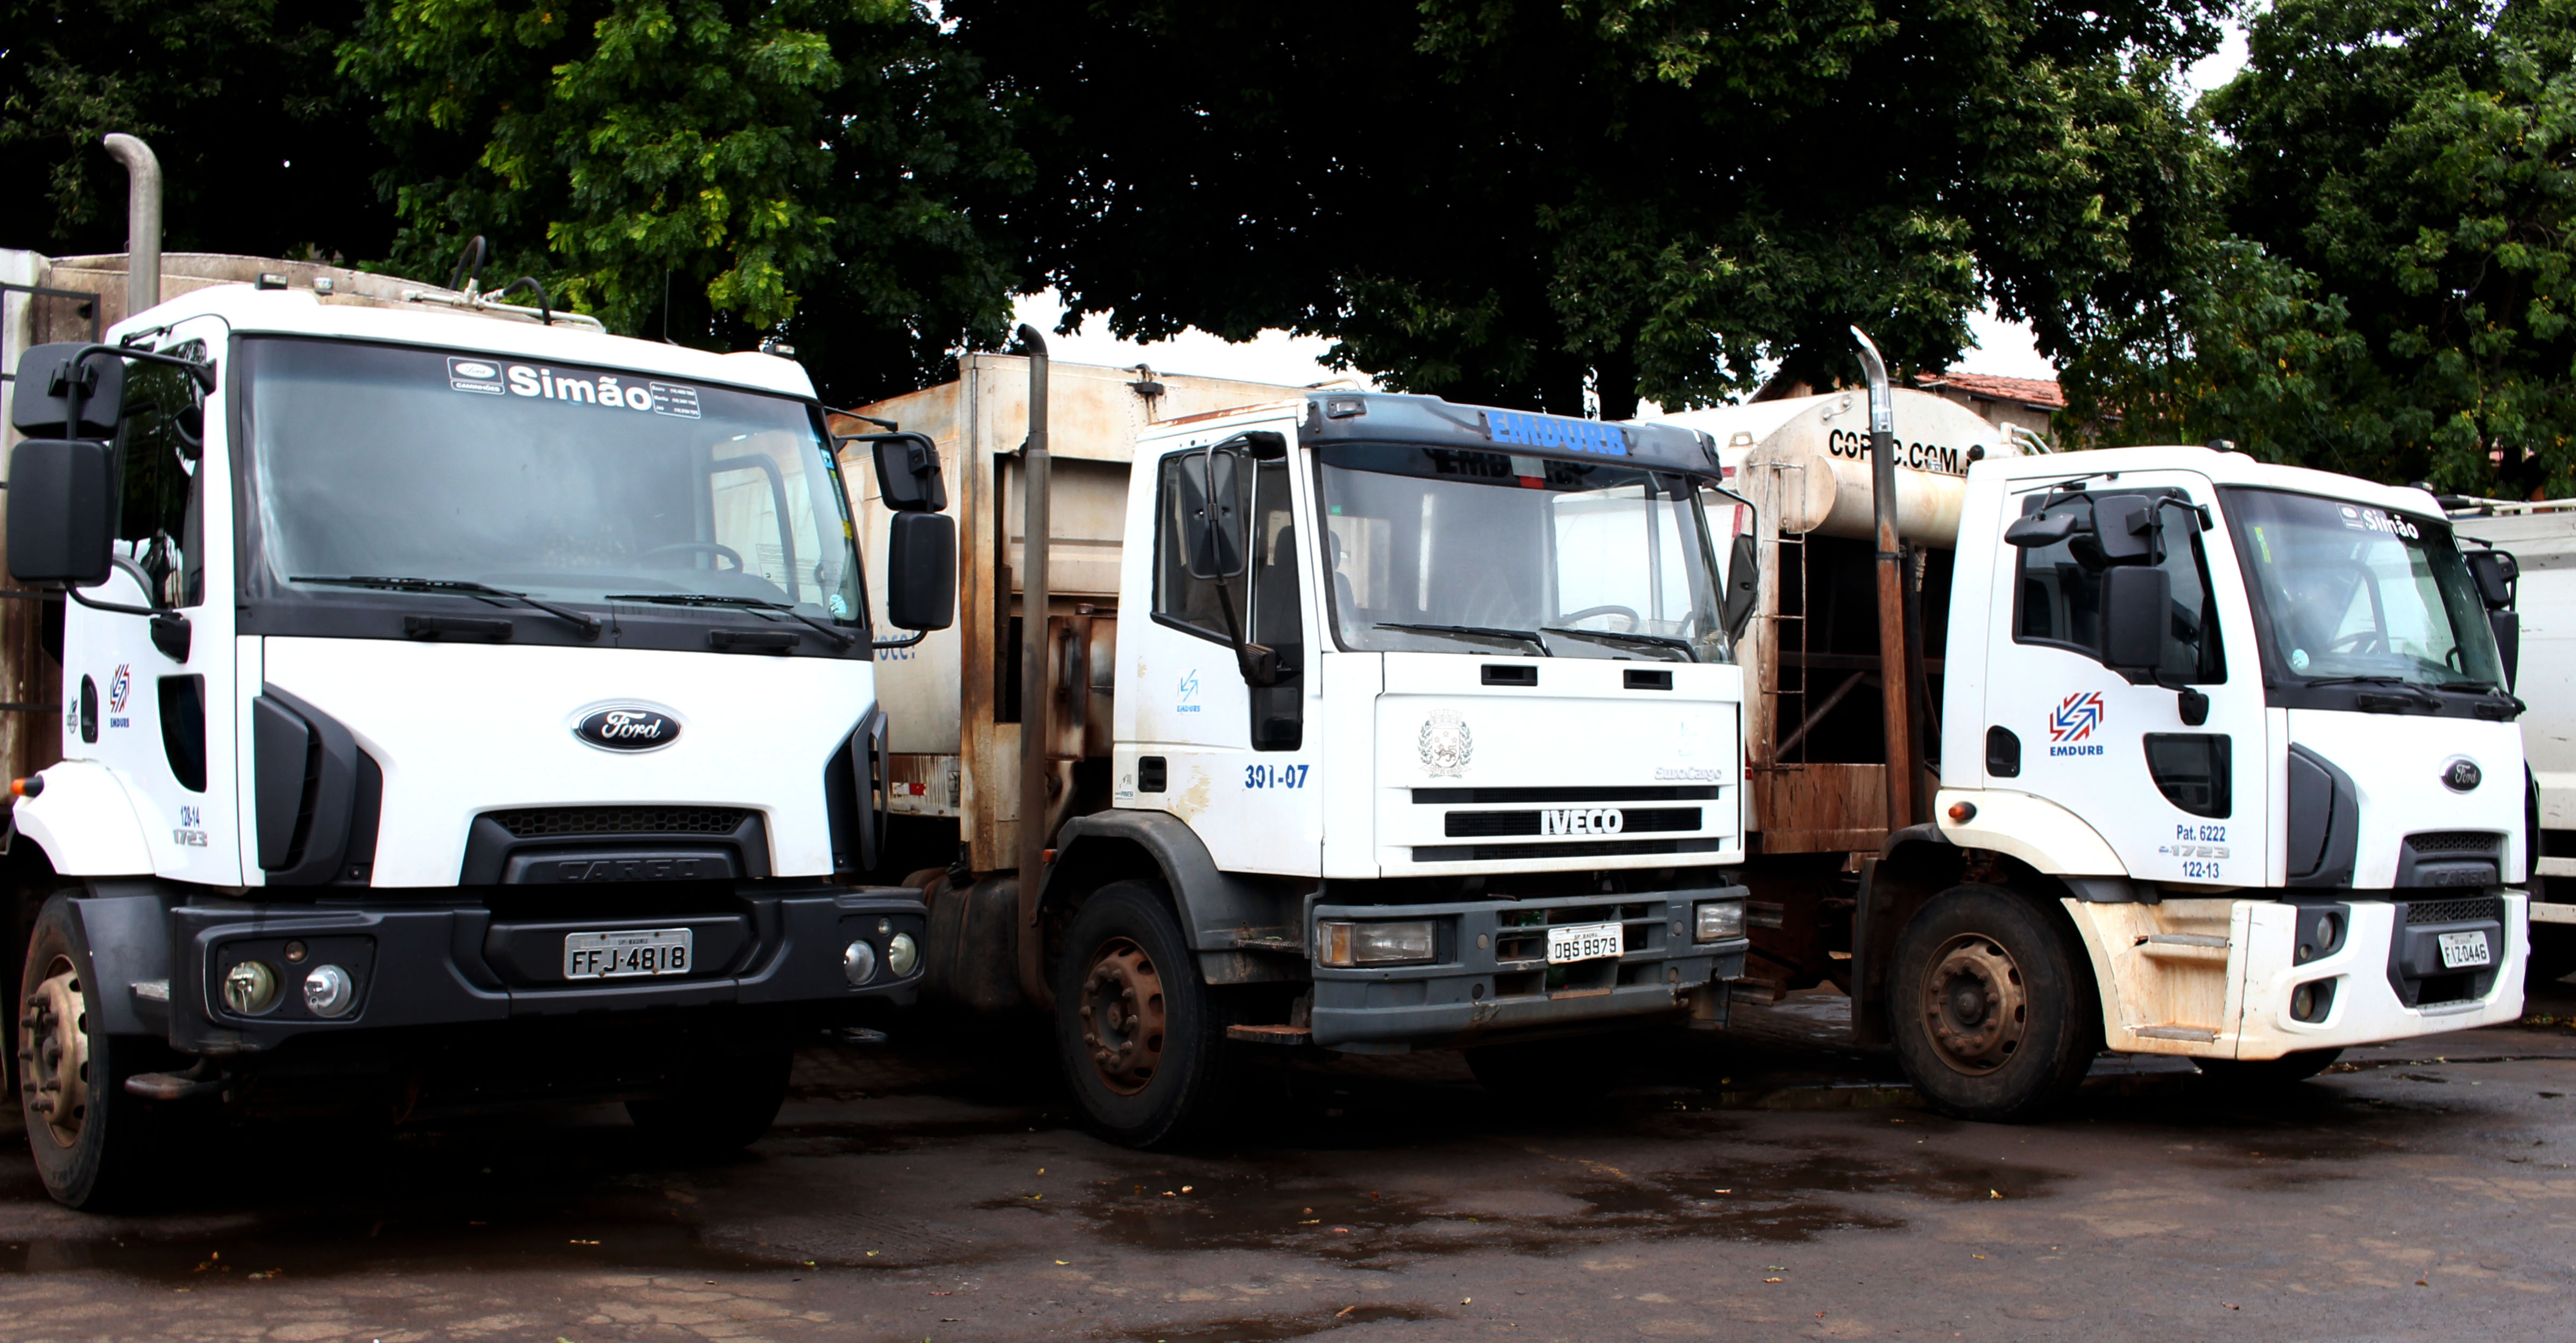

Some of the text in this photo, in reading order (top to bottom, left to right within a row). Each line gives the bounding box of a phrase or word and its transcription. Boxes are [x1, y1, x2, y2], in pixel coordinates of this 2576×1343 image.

[508, 365, 653, 411] Simão
[1487, 411, 1626, 456] EMDURB
[1829, 429, 1971, 475] COPC.COM.
[2362, 510, 2419, 540] Simão
[601, 711, 661, 738] Ford
[2050, 745, 2104, 757] EMDURB
[1245, 764, 1310, 789] 301-07
[2455, 764, 2476, 783] Ford
[1541, 809, 1623, 836] IVECO
[2177, 824, 2226, 842] Pat. 6222
[173, 829, 208, 847] 1723
[2171, 845, 2230, 859] 1723
[558, 859, 701, 882] CARGO
[2183, 861, 2219, 879] 122-13
